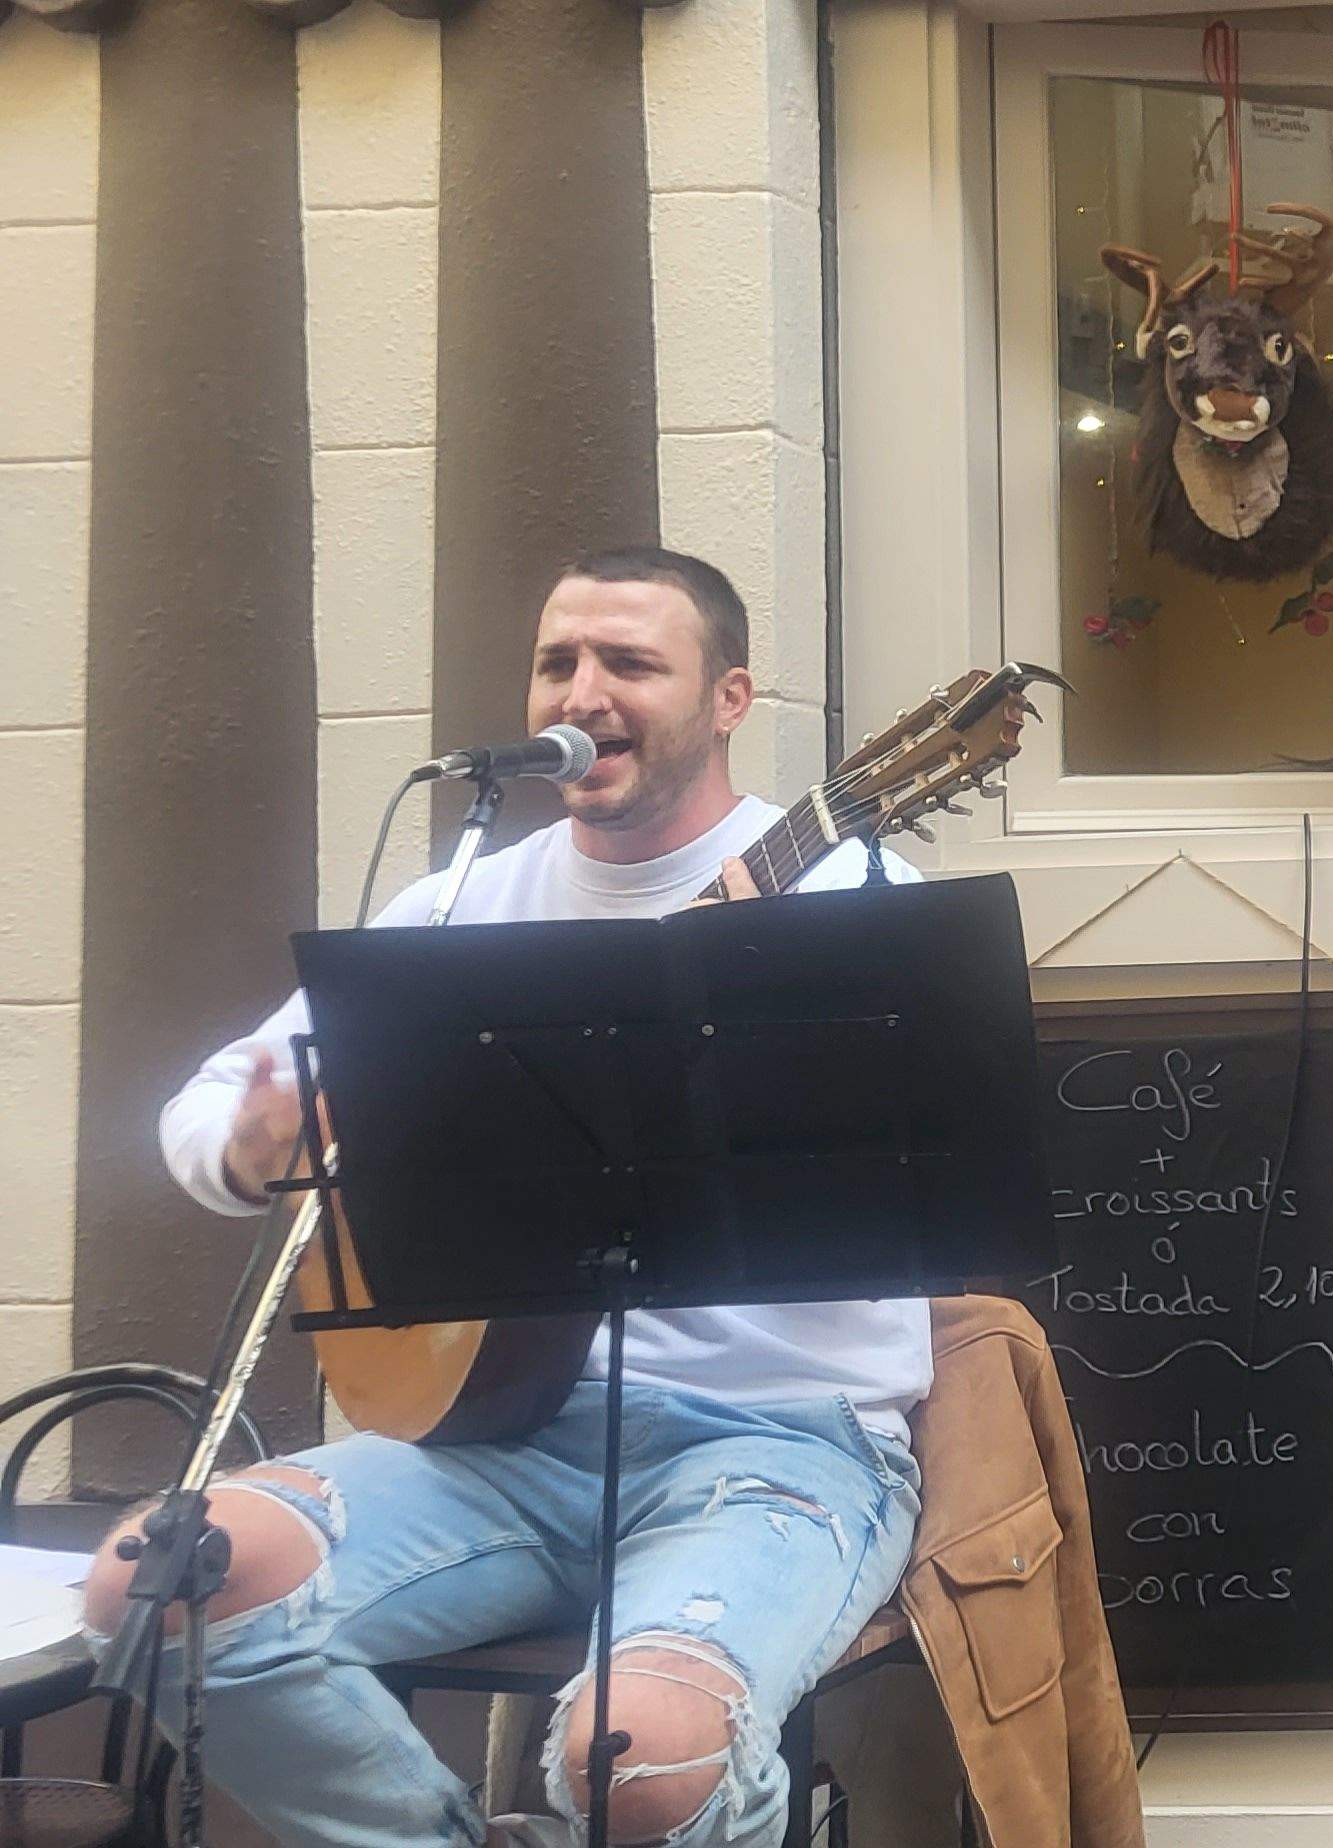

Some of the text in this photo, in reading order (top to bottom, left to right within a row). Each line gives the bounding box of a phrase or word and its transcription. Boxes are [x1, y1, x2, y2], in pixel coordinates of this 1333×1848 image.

[1057, 1048, 1224, 1140] Café
[1027, 1264, 1231, 1315] Tostada
[1066, 1398, 1299, 1473] hocolate
[1126, 1511, 1226, 1543] con
